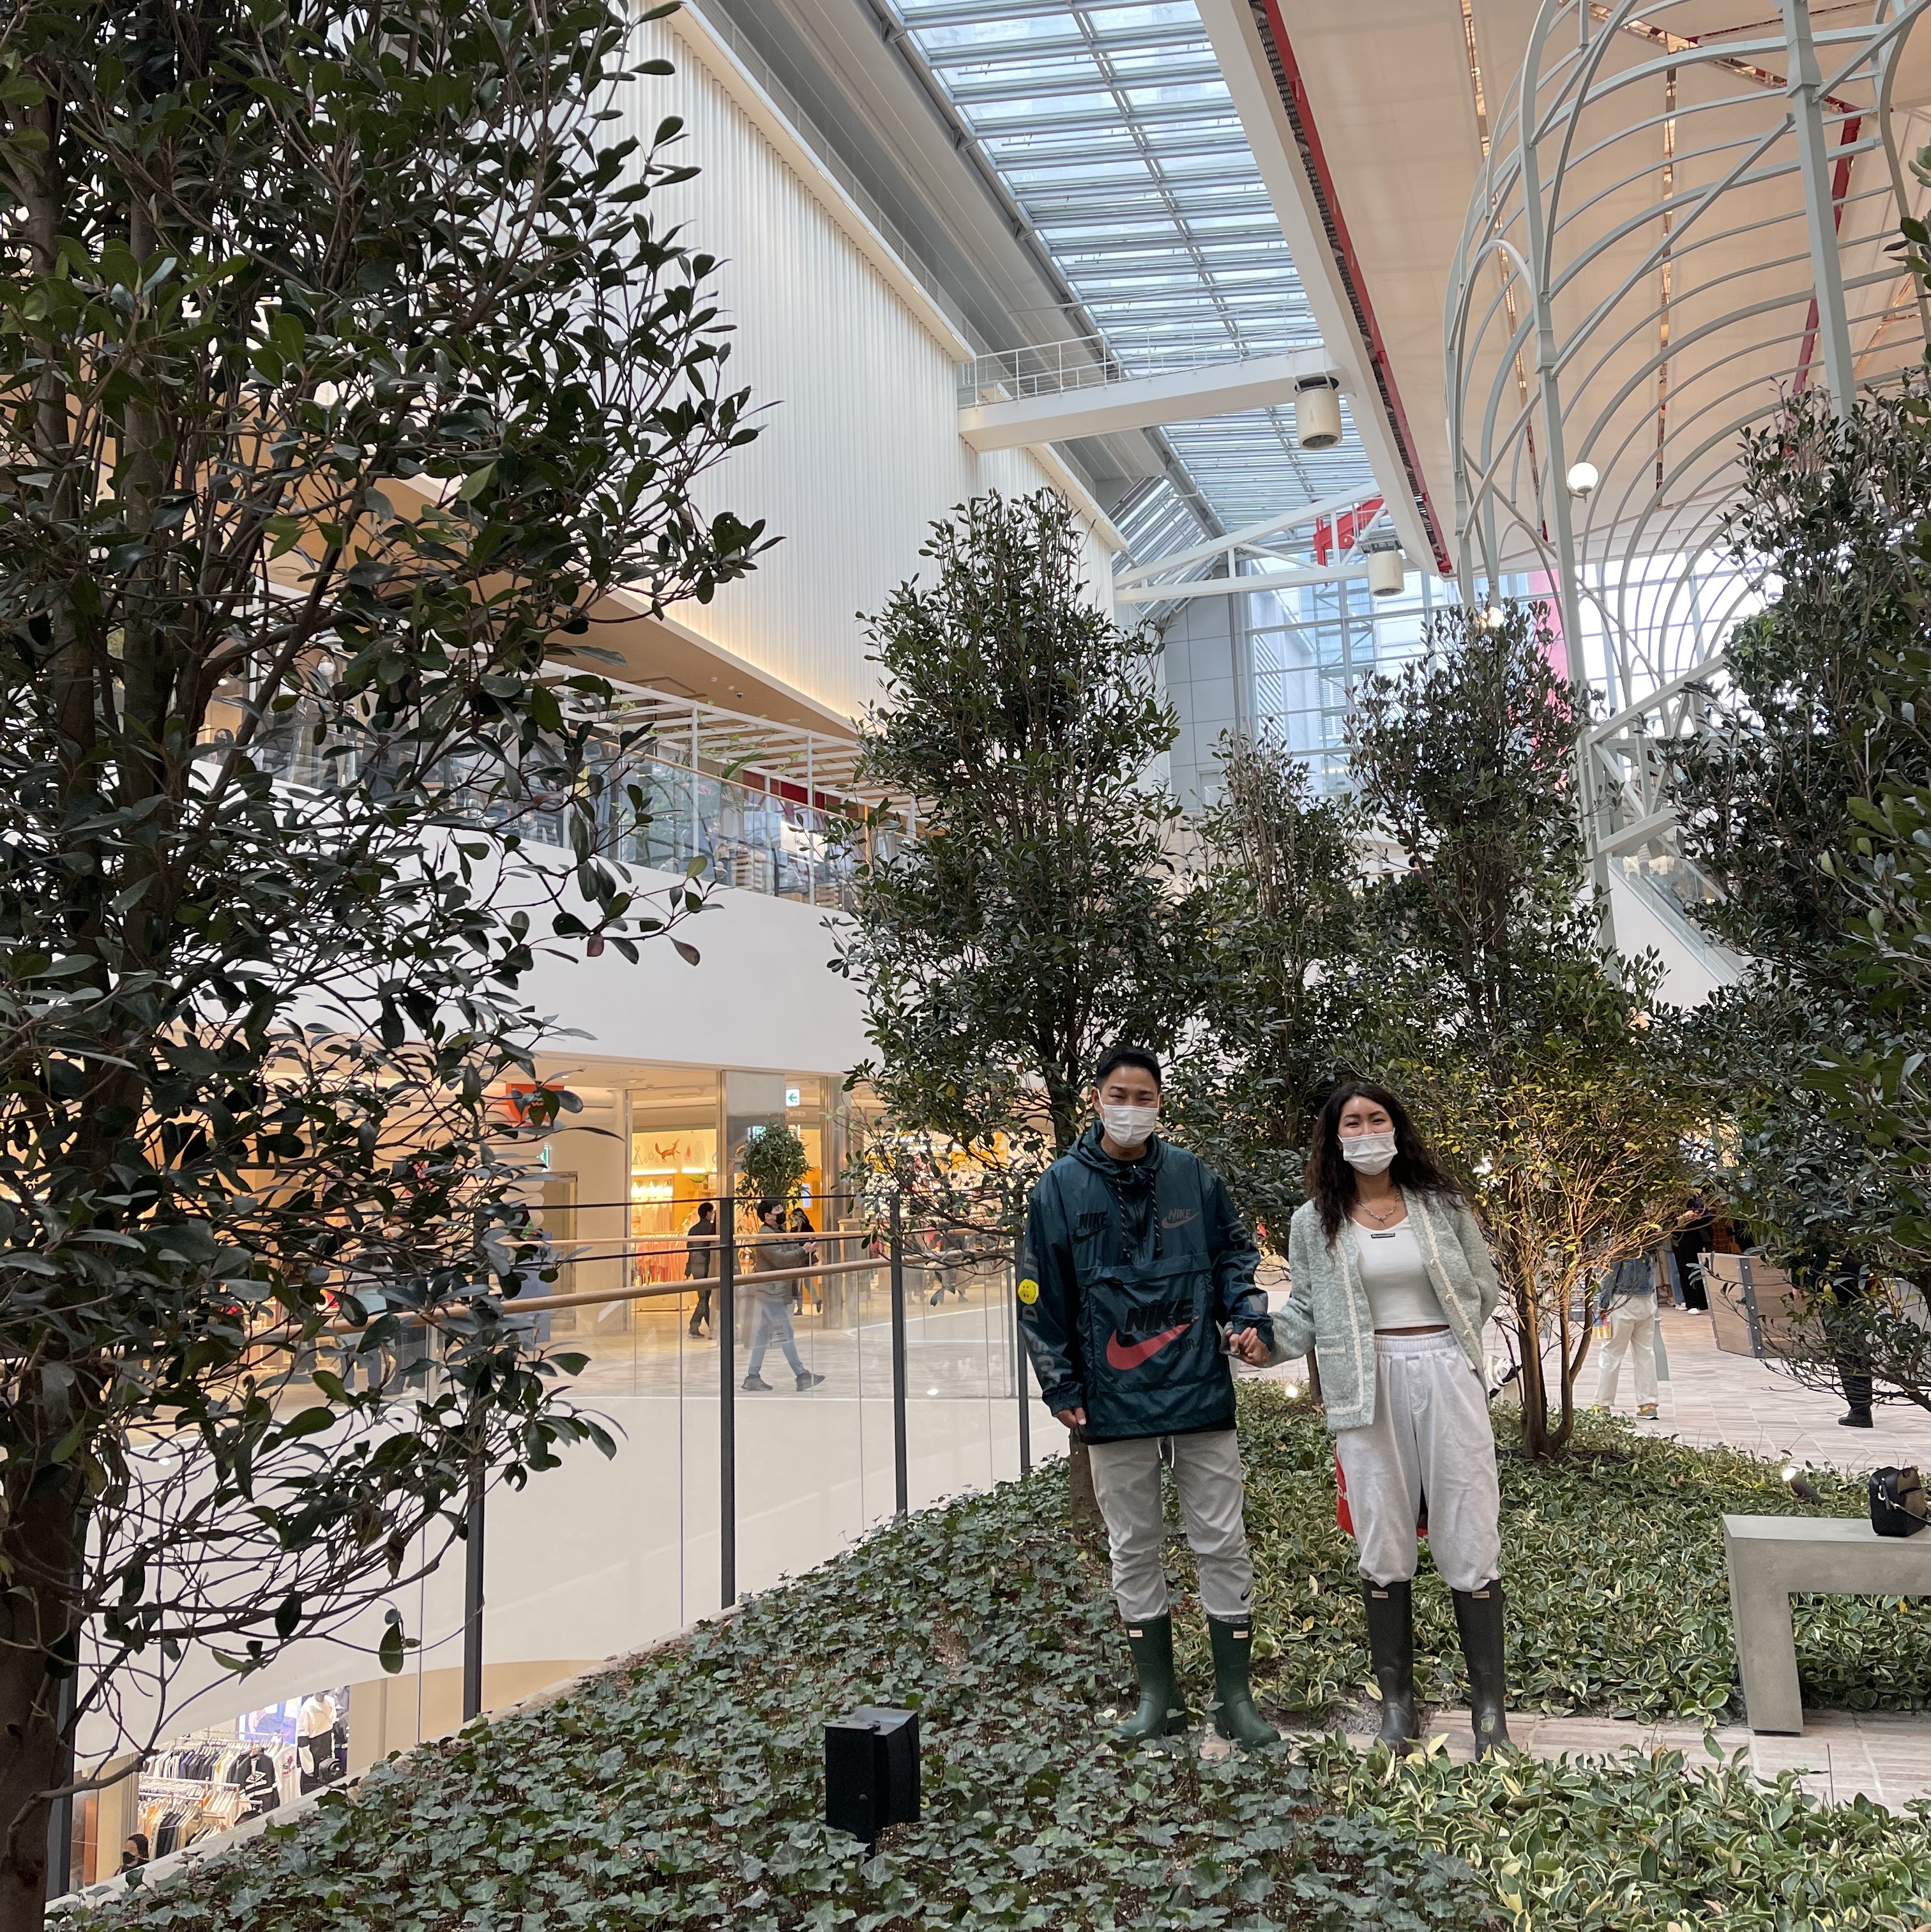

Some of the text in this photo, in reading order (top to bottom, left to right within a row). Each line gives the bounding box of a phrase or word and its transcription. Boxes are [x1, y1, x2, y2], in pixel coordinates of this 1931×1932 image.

[1078, 1212, 1108, 1229] NIKE
[1168, 1208, 1192, 1220] NIKE
[1124, 1298, 1193, 1333] NIKE
